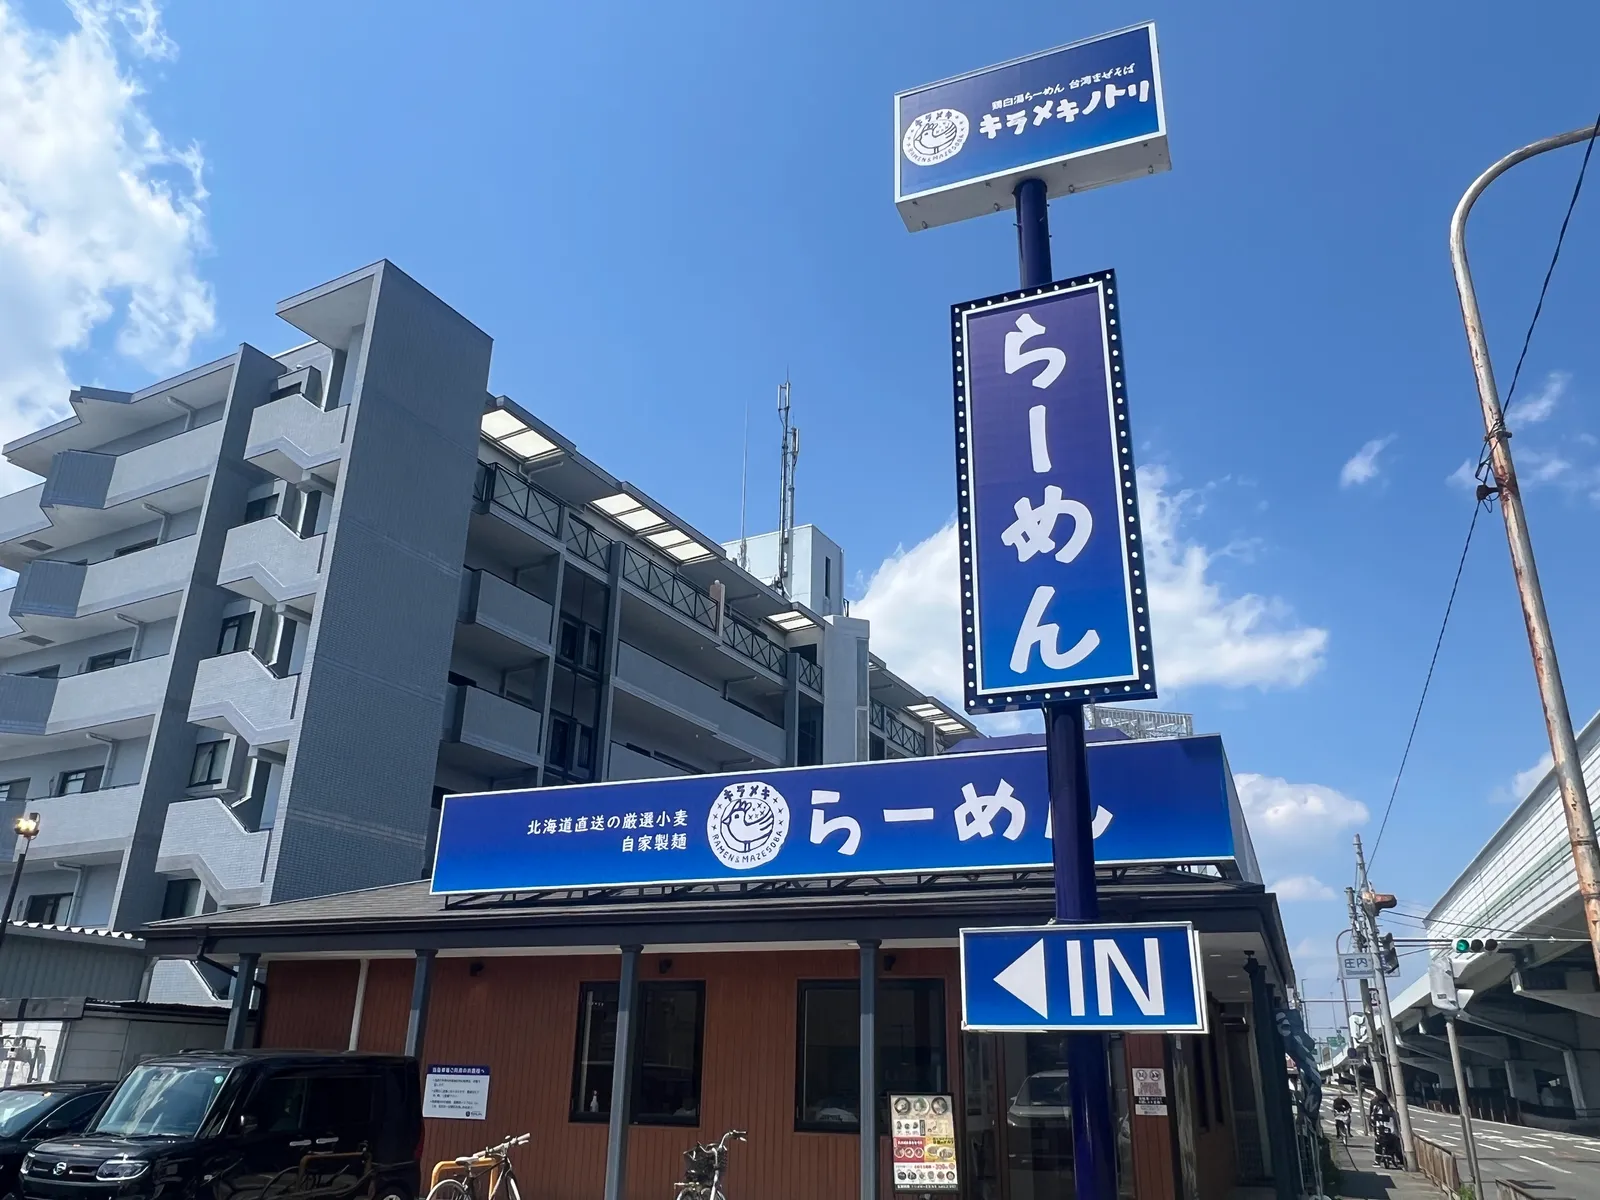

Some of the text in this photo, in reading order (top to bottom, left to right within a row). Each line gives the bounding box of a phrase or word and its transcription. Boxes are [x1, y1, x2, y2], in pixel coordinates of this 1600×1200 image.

[1069, 62, 1136, 90] 台湾まぜそば
[979, 80, 1150, 139] キラメキノトリ
[1000, 313, 1100, 674] らーめん
[723, 784, 770, 802] キラメキ
[527, 809, 689, 835] 北海道直送の厳選小麦
[621, 832, 688, 853] 自家製麺
[1344, 957, 1369, 969] 庄内
[1066, 937, 1166, 1017] IN
